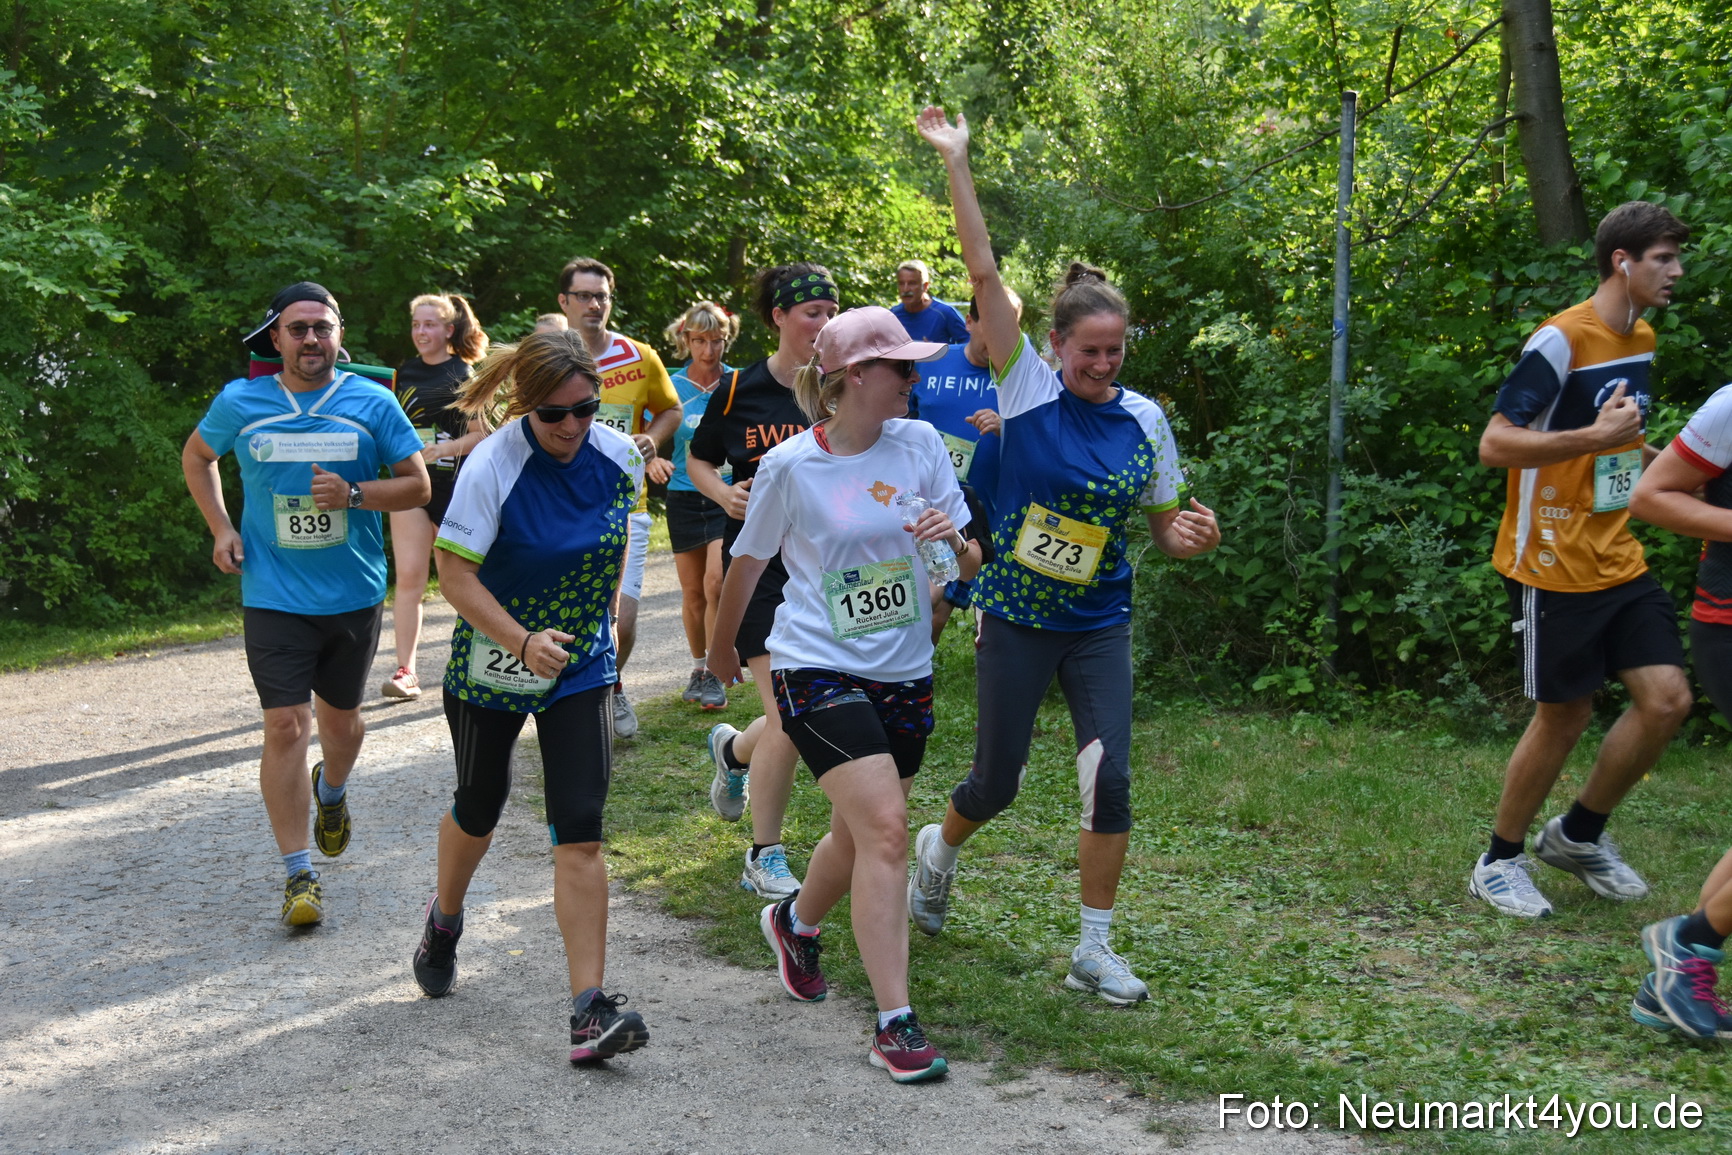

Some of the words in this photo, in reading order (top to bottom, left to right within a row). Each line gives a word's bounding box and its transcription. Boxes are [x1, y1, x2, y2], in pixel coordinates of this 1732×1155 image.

[603, 368, 646, 389] BÖGL
[596, 418, 625, 433] 85
[745, 427, 757, 448] BIT
[1608, 471, 1631, 495] 785
[289, 513, 331, 534] 839
[1032, 533, 1083, 565] 273
[1026, 550, 1064, 570] Sonnenberg
[1065, 565, 1082, 574] Silvia
[840, 583, 906, 618] 1360
[856, 613, 882, 624] Rückert
[883, 610, 899, 618] Julia
[484, 669, 511, 682] Keilhold
[512, 676, 539, 684] Claudia
